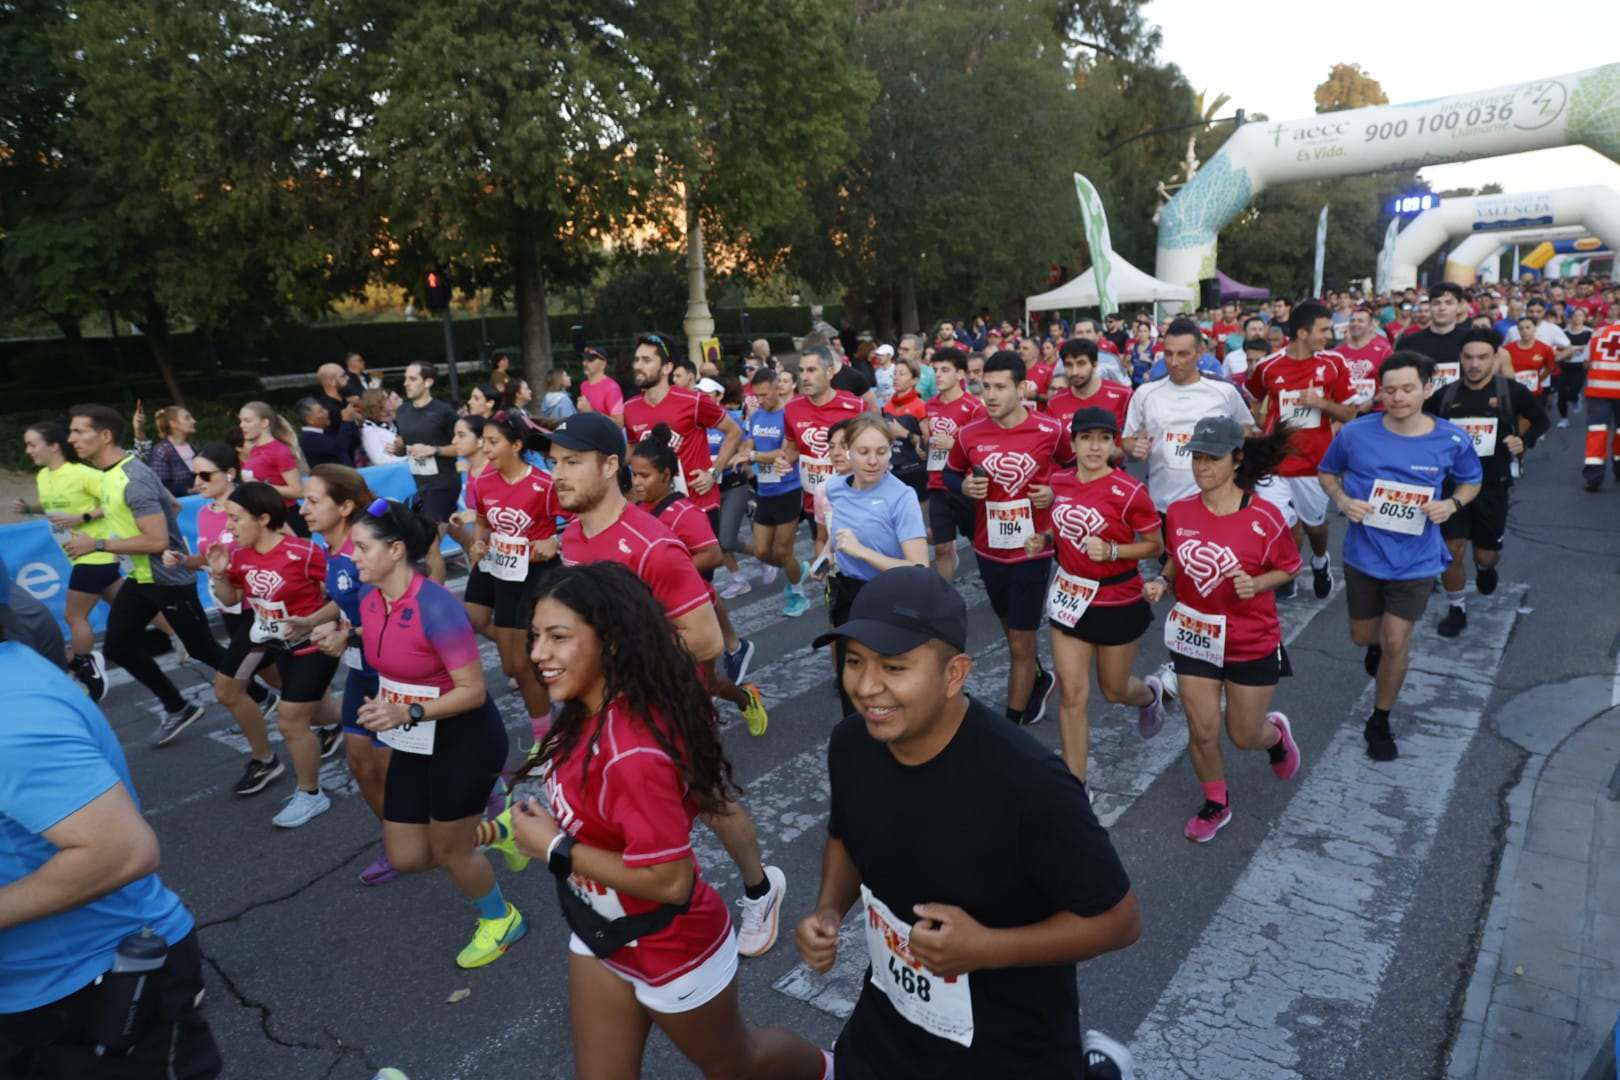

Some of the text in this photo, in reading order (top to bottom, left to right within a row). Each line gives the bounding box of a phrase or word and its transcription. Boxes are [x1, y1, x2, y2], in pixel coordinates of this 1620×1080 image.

[1364, 102, 1513, 143] 900 100 036
[1379, 502, 1417, 520] 6035
[999, 521, 1022, 536] 1194
[495, 552, 518, 569] 2072
[1053, 590, 1079, 612] 3414
[1176, 627, 1211, 649] 3205
[888, 955, 931, 1003] 468
